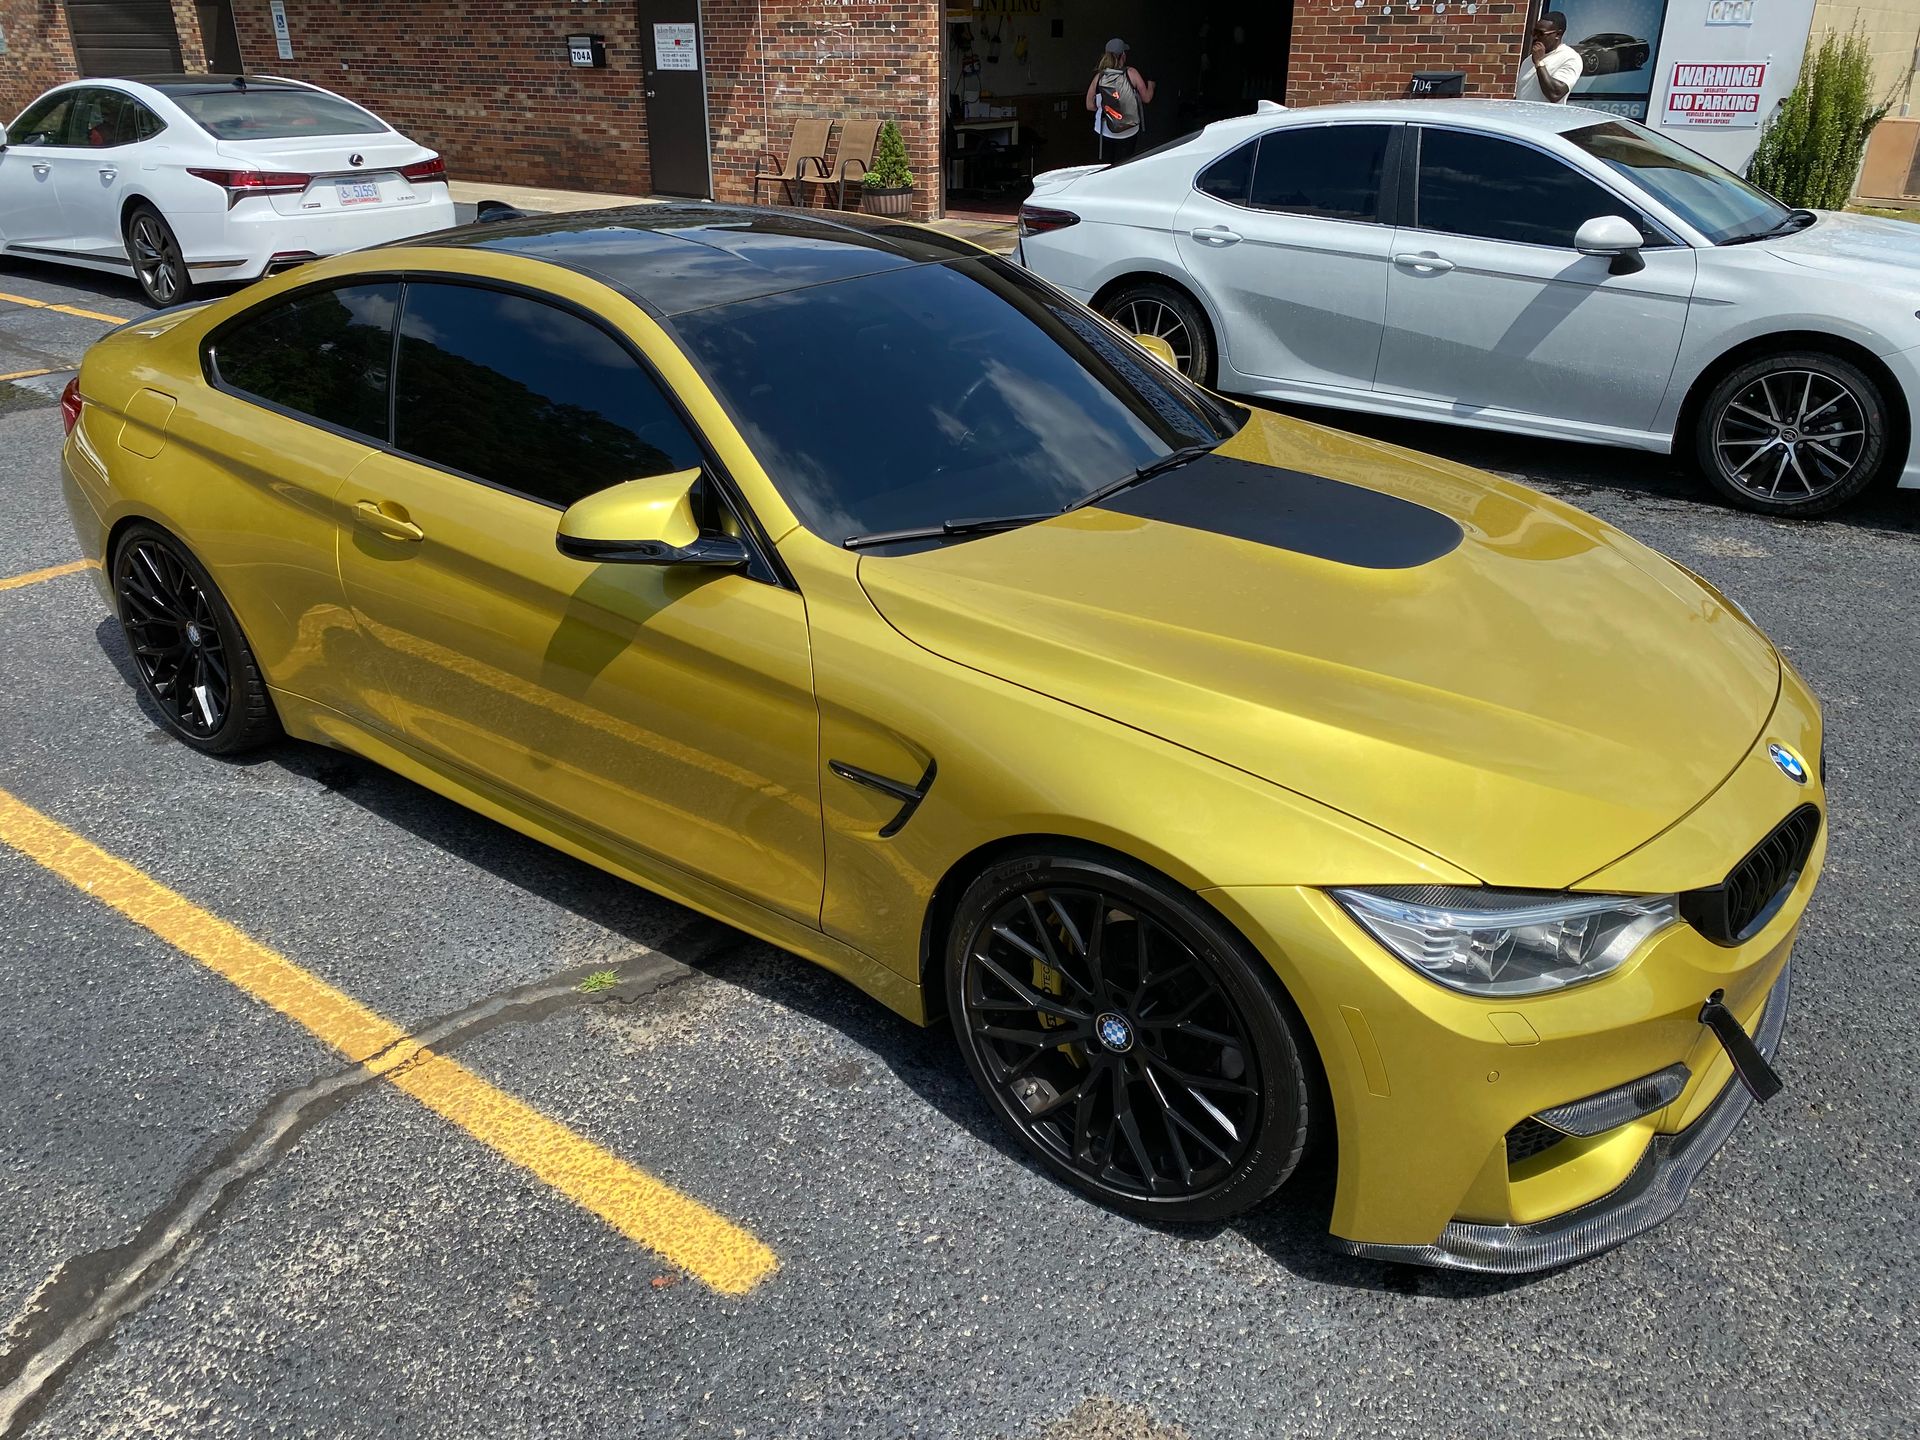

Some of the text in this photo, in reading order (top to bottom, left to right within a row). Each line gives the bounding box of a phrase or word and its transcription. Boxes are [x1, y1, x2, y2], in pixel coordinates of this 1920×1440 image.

[572, 51, 592, 61] 704A
[1677, 66, 1762, 87] WARNING!
[1412, 79, 1432, 92] 704
[1672, 94, 1756, 111] NO PARKING
